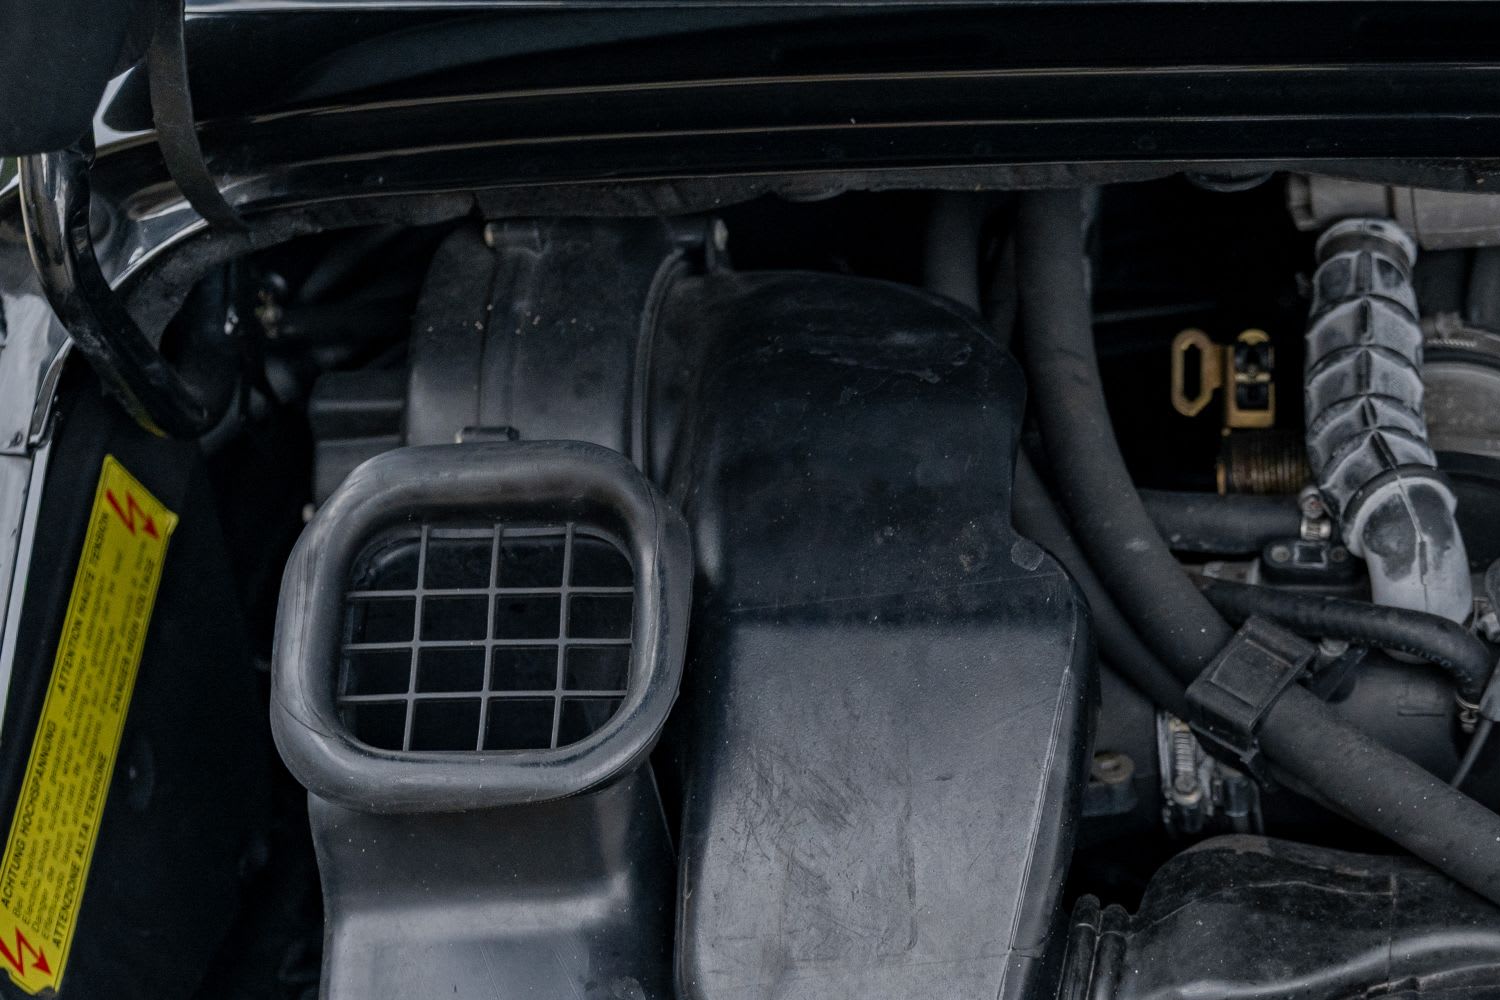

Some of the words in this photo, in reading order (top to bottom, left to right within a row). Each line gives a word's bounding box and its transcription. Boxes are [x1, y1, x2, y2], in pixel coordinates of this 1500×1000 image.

[0, 835, 26, 911] ACHTUNG
[18, 717, 57, 837] HOCHSPANNUNG
[51, 859, 81, 951] ATTENZIONE
[73, 819, 91, 860] ALTA
